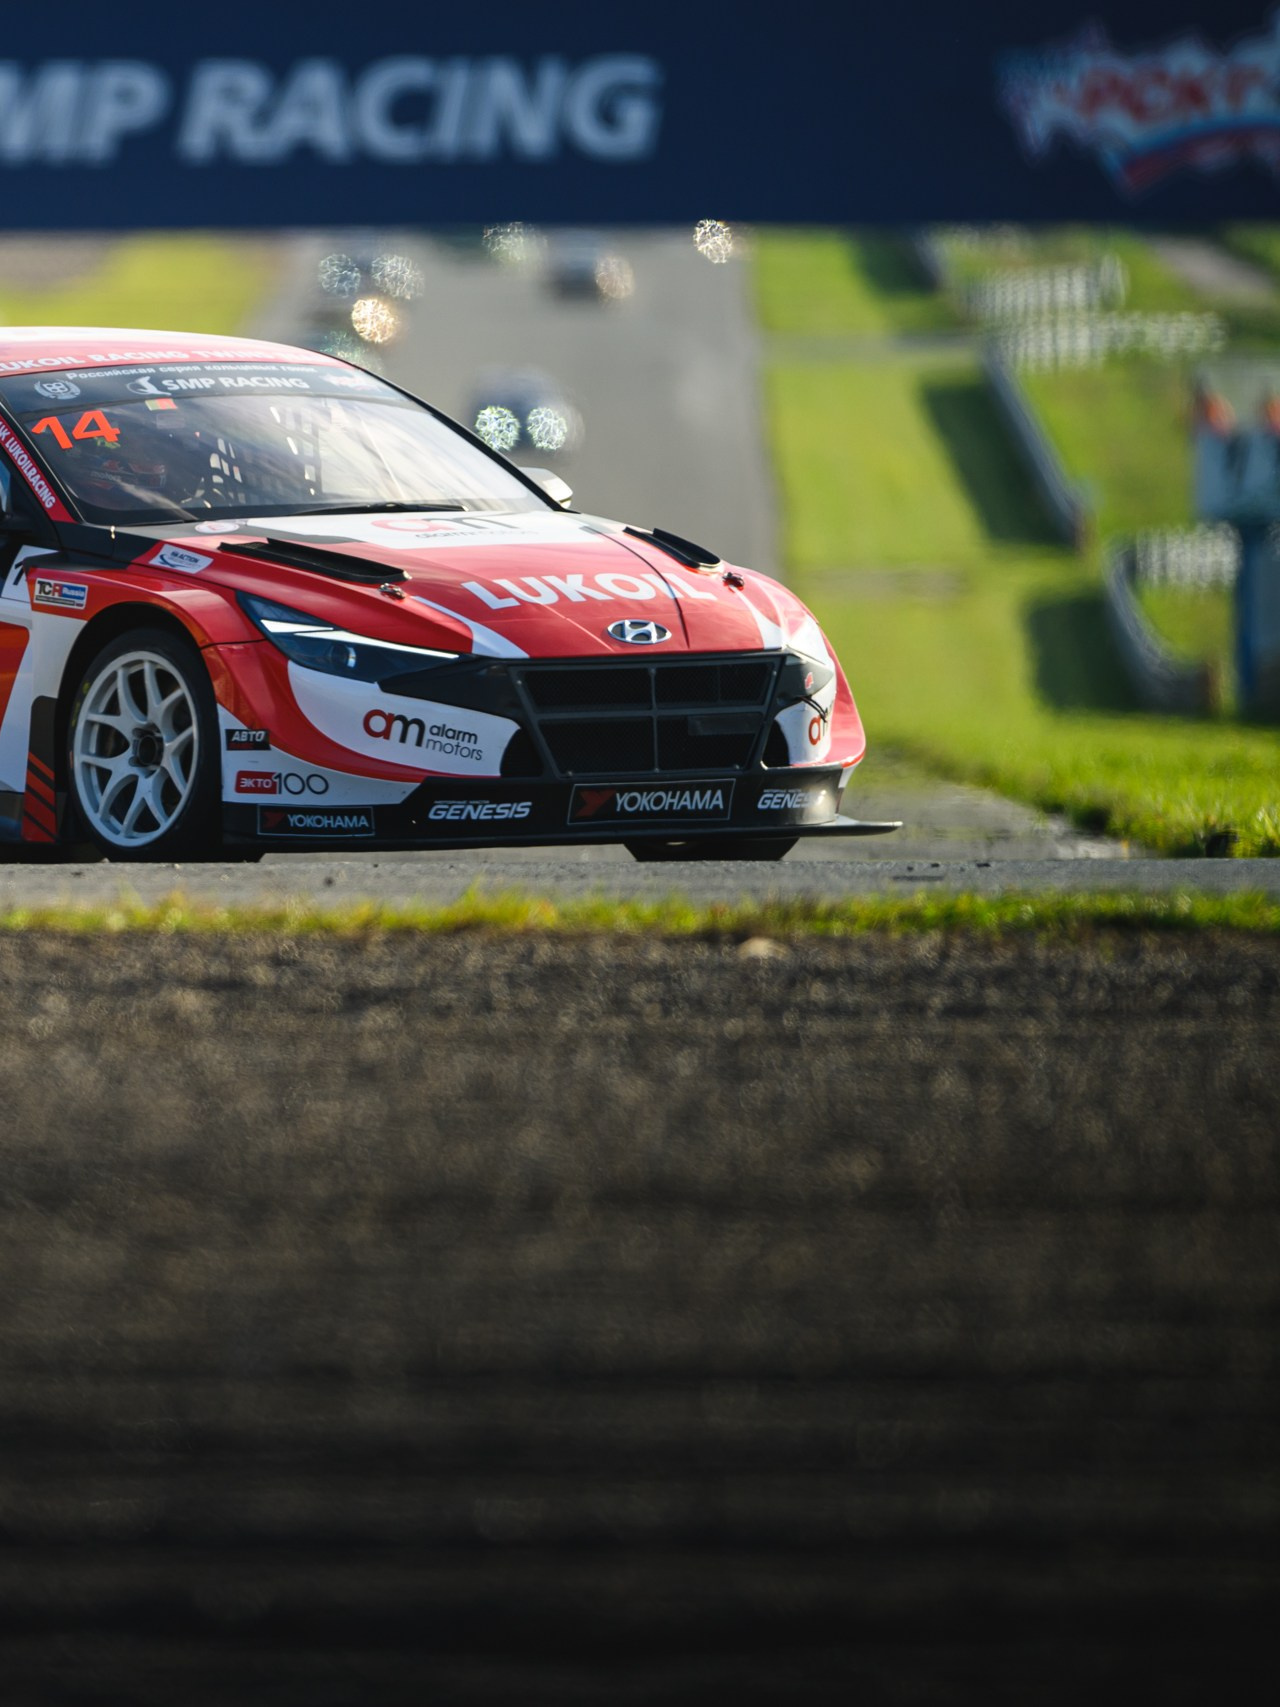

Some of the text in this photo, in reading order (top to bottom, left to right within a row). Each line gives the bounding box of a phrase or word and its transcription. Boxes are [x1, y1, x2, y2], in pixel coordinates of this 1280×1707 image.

[179, 54, 661, 165] RACING
[88, 350, 190, 363] RACING
[66, 365, 156, 380] Российская
[159, 365, 201, 374] серия
[162, 376, 310, 391] SMP RACING
[31, 410, 120, 449] 14
[37, 580, 62, 597] TCR
[460, 572, 719, 611] LUKOIL
[231, 730, 267, 742] АВТО
[428, 723, 479, 746] alarm
[426, 737, 483, 761] motors
[615, 789, 724, 812] YOKOHAMA
[428, 801, 533, 820] GENESIS
[287, 813, 369, 828] YOKOHAMA
